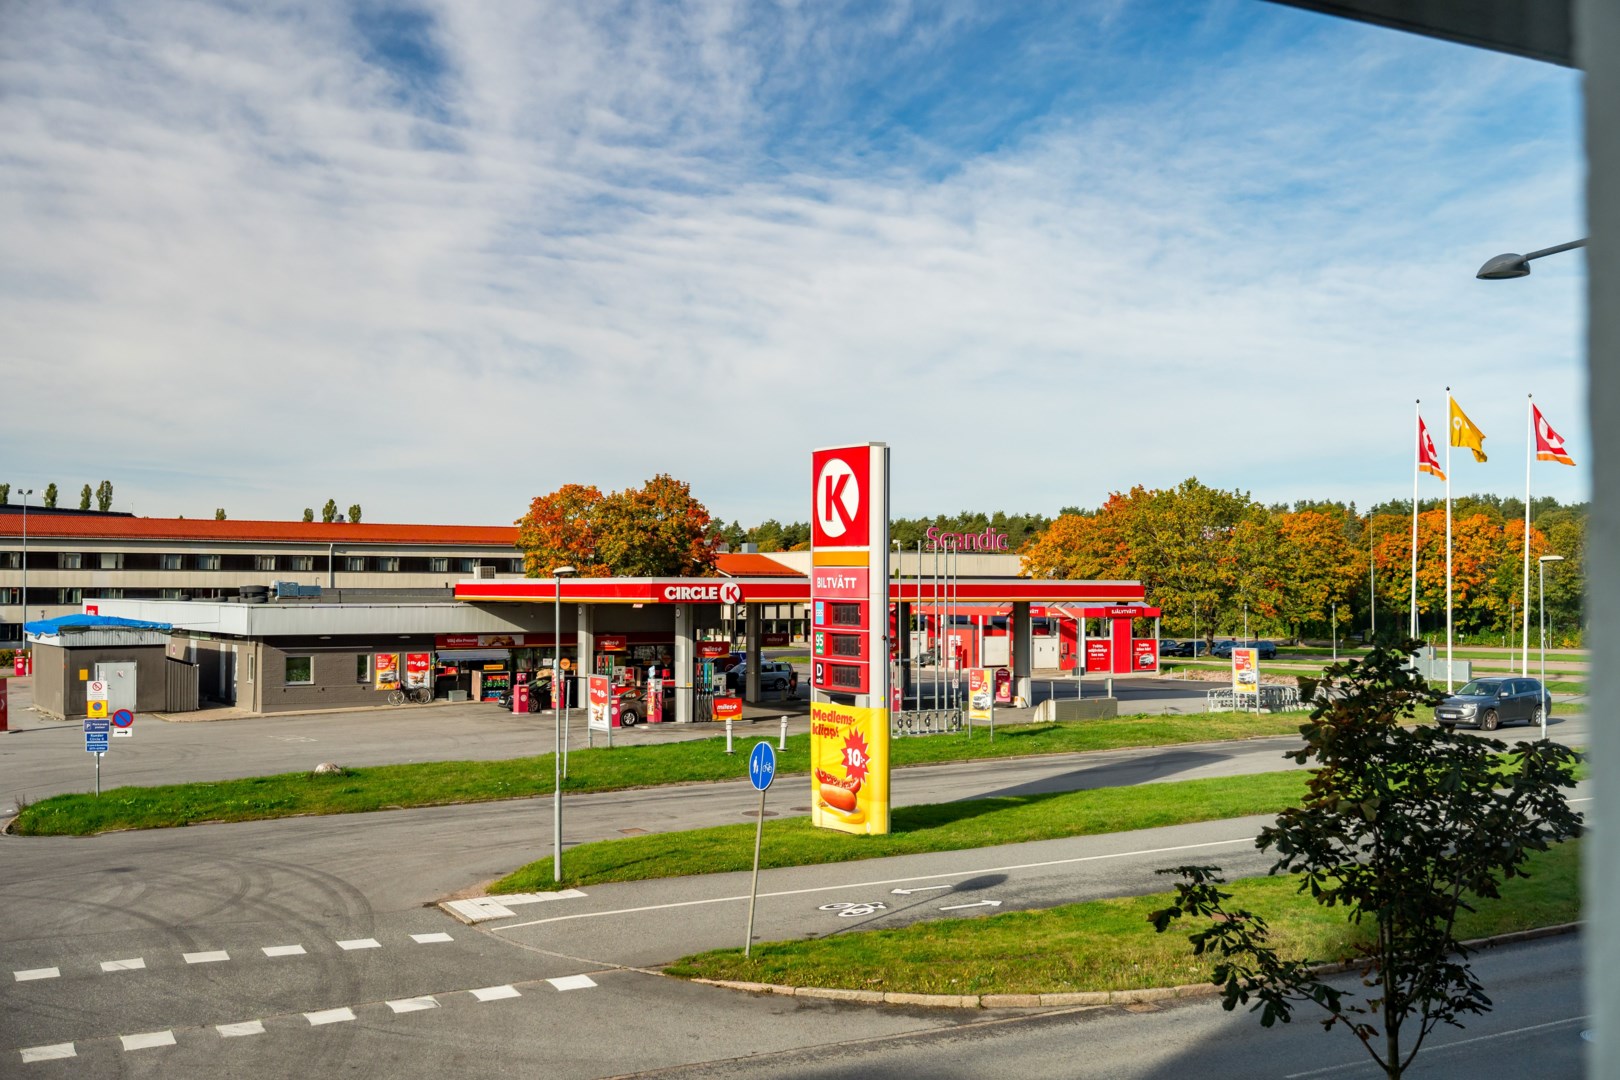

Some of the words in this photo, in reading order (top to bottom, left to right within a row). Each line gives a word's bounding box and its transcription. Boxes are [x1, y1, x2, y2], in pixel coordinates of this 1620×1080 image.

[824, 472, 854, 534] K
[926, 526, 1009, 551] Scandic
[816, 575, 857, 589] BILTVÄTT
[664, 586, 718, 600] CIRCLE
[815, 633, 824, 647] 95
[816, 663, 823, 677] D
[716, 702, 738, 711] miles+
[812, 708, 856, 726] Medlems-
[812, 722, 839, 739] klipp!
